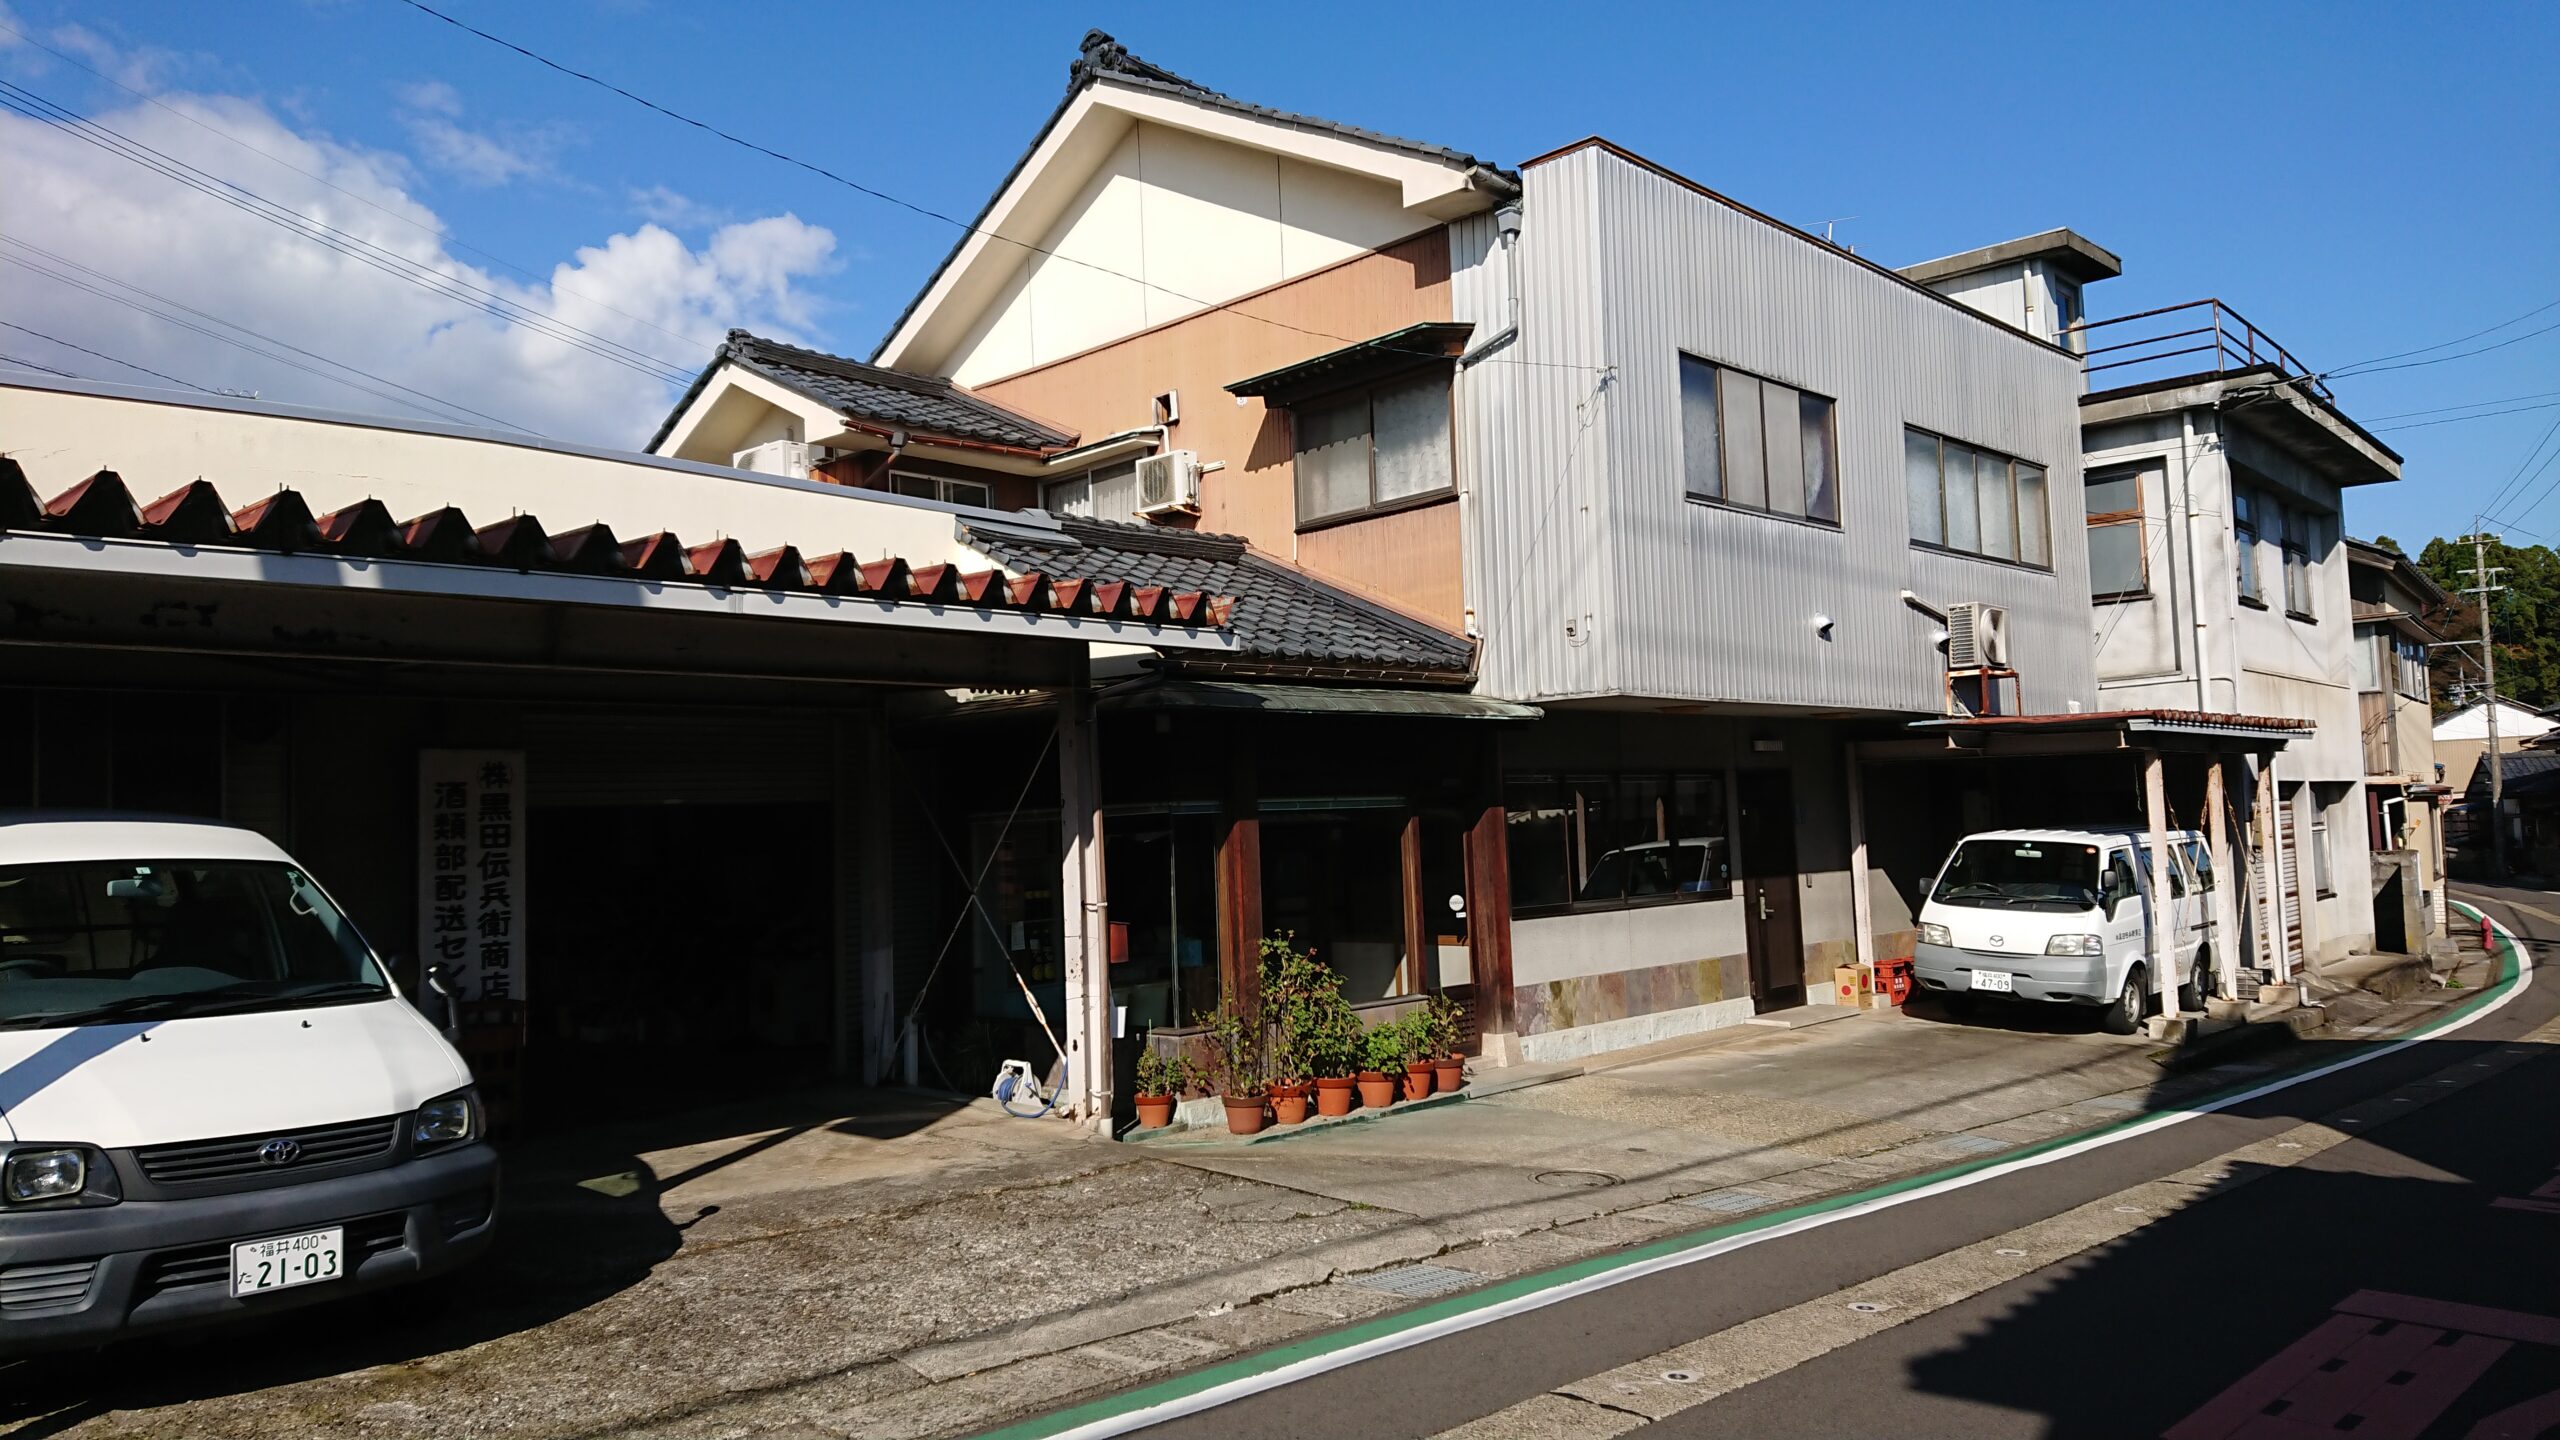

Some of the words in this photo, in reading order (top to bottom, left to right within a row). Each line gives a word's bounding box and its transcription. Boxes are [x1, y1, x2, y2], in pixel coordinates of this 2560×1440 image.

[1981, 978, 2010, 990] 47-09
[260, 1240, 289, 1258] 福井
[292, 1235, 319, 1252] 400
[238, 1271, 252, 1285] た
[257, 1249, 336, 1289] 21-03
